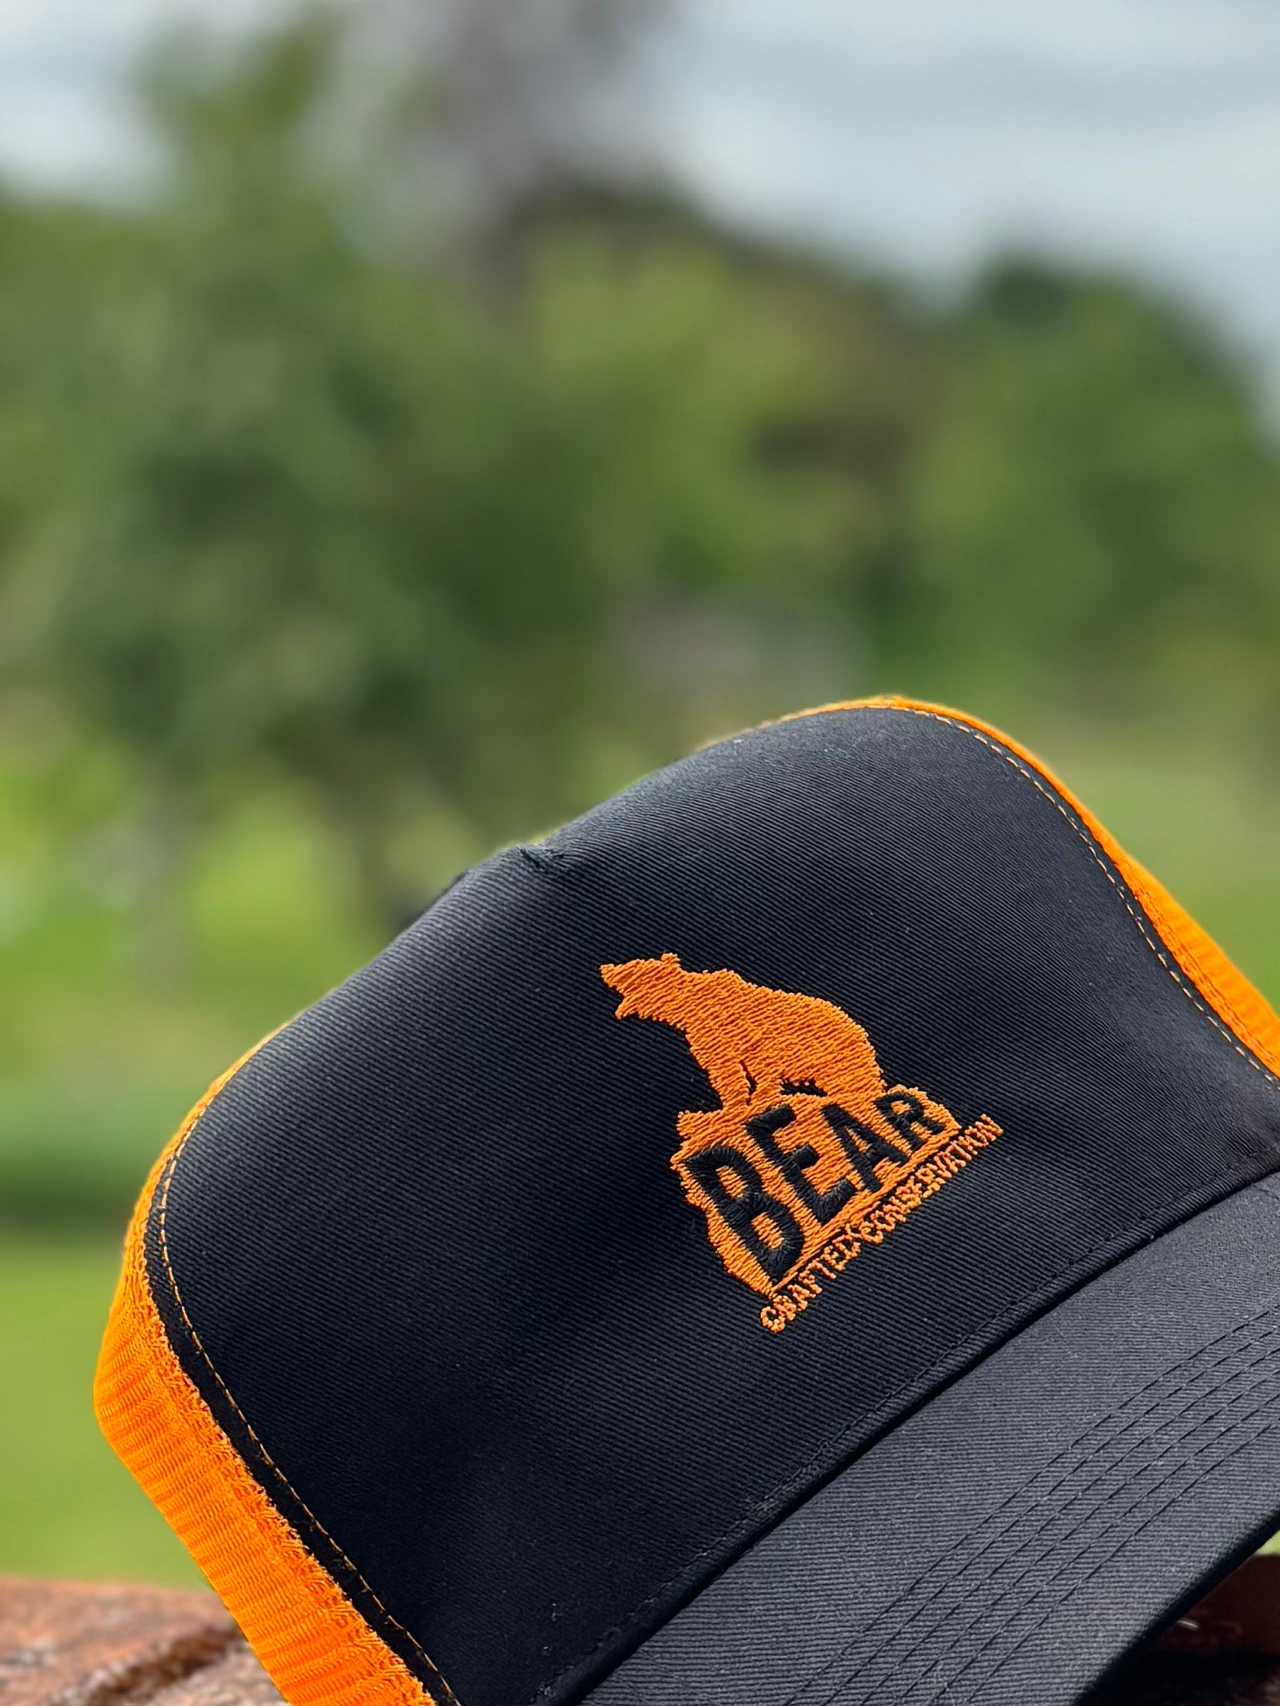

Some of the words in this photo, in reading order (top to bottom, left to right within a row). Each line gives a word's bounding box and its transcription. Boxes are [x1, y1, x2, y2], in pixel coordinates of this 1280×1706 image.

[683, 1092, 946, 1277] BEAR
[759, 1223, 861, 1334] CRAFTED
[859, 1113, 1004, 1245] CONSERVATION
